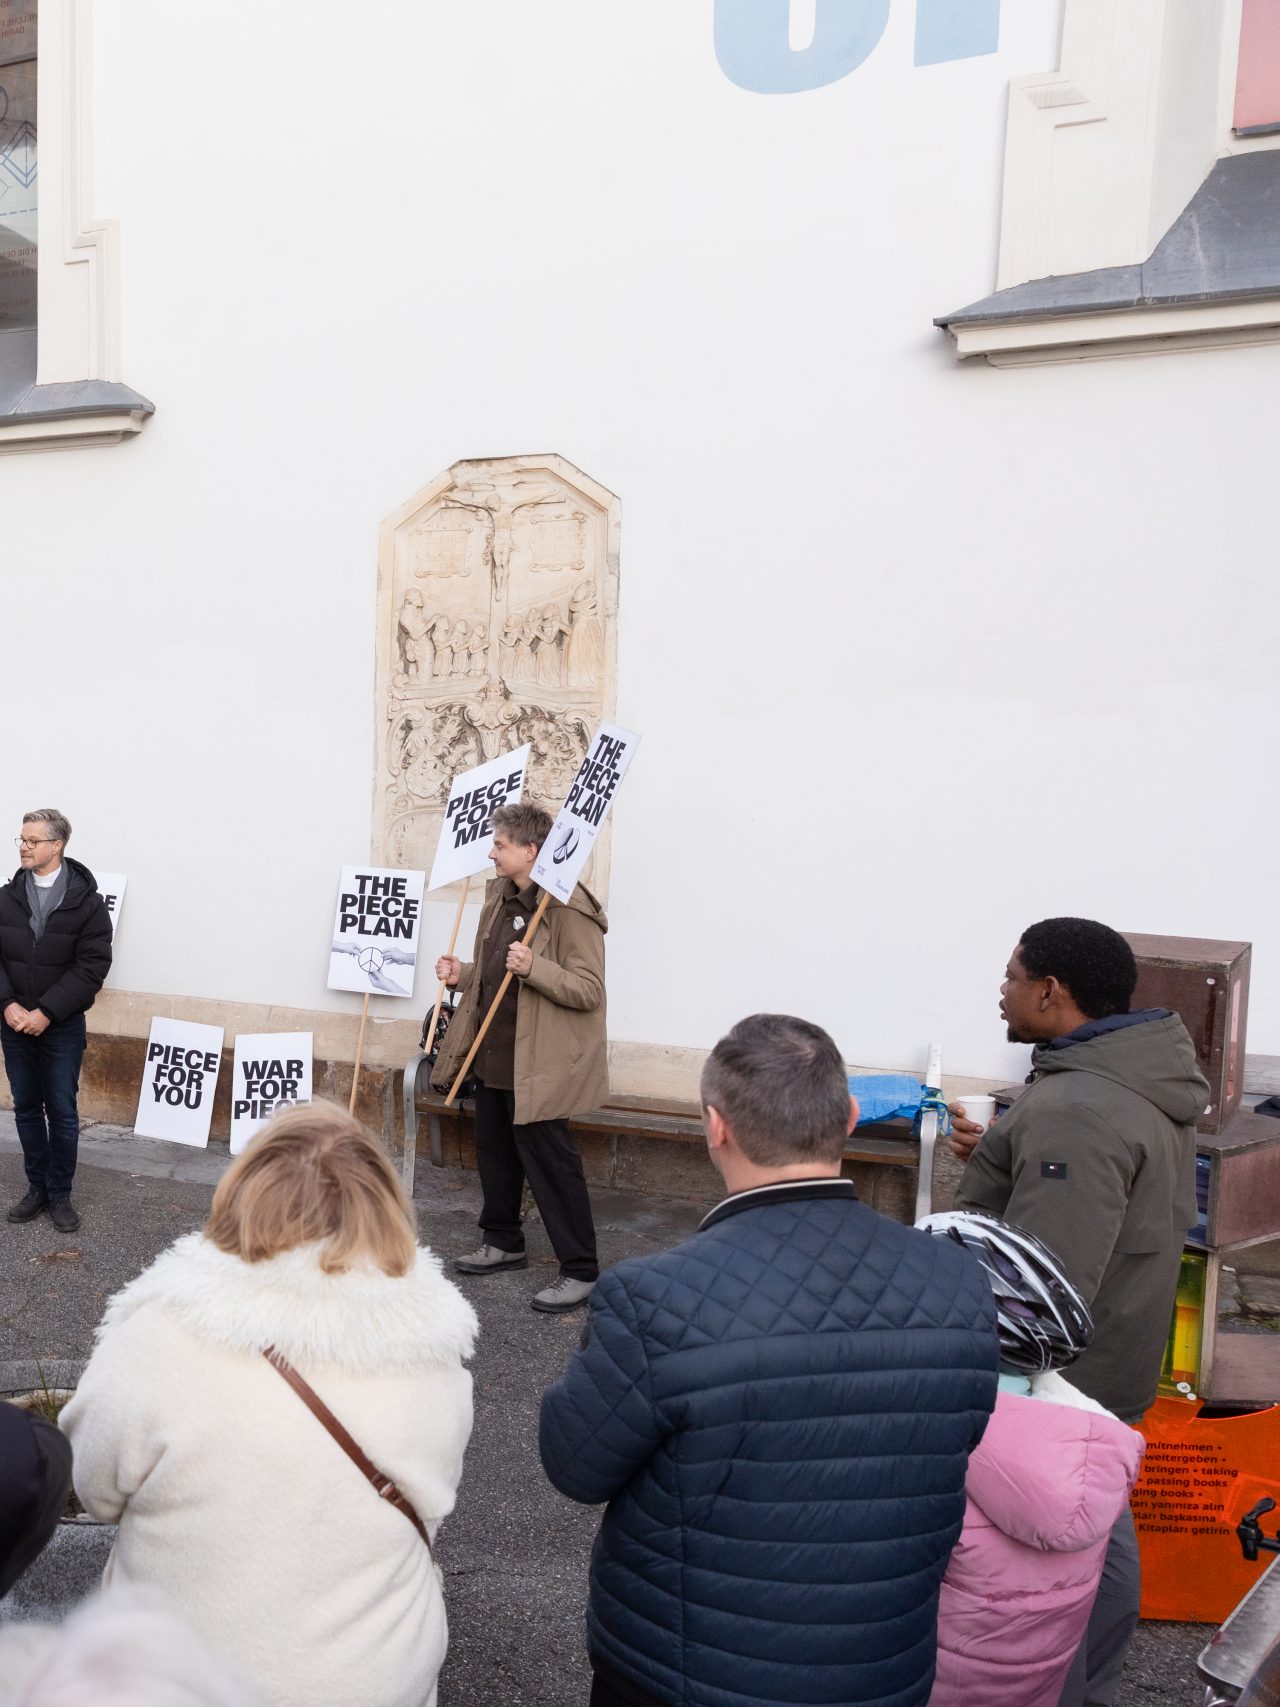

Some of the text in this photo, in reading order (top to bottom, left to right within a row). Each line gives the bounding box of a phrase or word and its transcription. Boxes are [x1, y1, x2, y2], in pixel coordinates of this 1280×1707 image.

[593, 733, 627, 770] THE
[574, 757, 620, 800] PIECE
[445, 769, 523, 819] PIECE
[564, 783, 608, 828] PLAN
[452, 795, 508, 833] FOR
[453, 818, 494, 850] ME
[354, 874, 408, 898] THE
[339, 893, 419, 919] PIECE
[339, 913, 415, 939] PLAN
[147, 1042, 219, 1073] PIECE
[242, 1059, 304, 1080] WAR
[154, 1063, 205, 1090] FOR
[152, 1082, 203, 1110] YOU
[245, 1079, 299, 1100] FOR
[234, 1099, 310, 1120] PIE
[1145, 1454, 1218, 1464] weitergeben
[1146, 1442, 1214, 1451] mitnehmen
[1144, 1465, 1239, 1478] bringen taking
[1146, 1477, 1228, 1488] passing books
[1129, 1499, 1148, 1508] ları
[1131, 1488, 1194, 1498] ging books
[1138, 1523, 1230, 1536] Kitapları getirin
